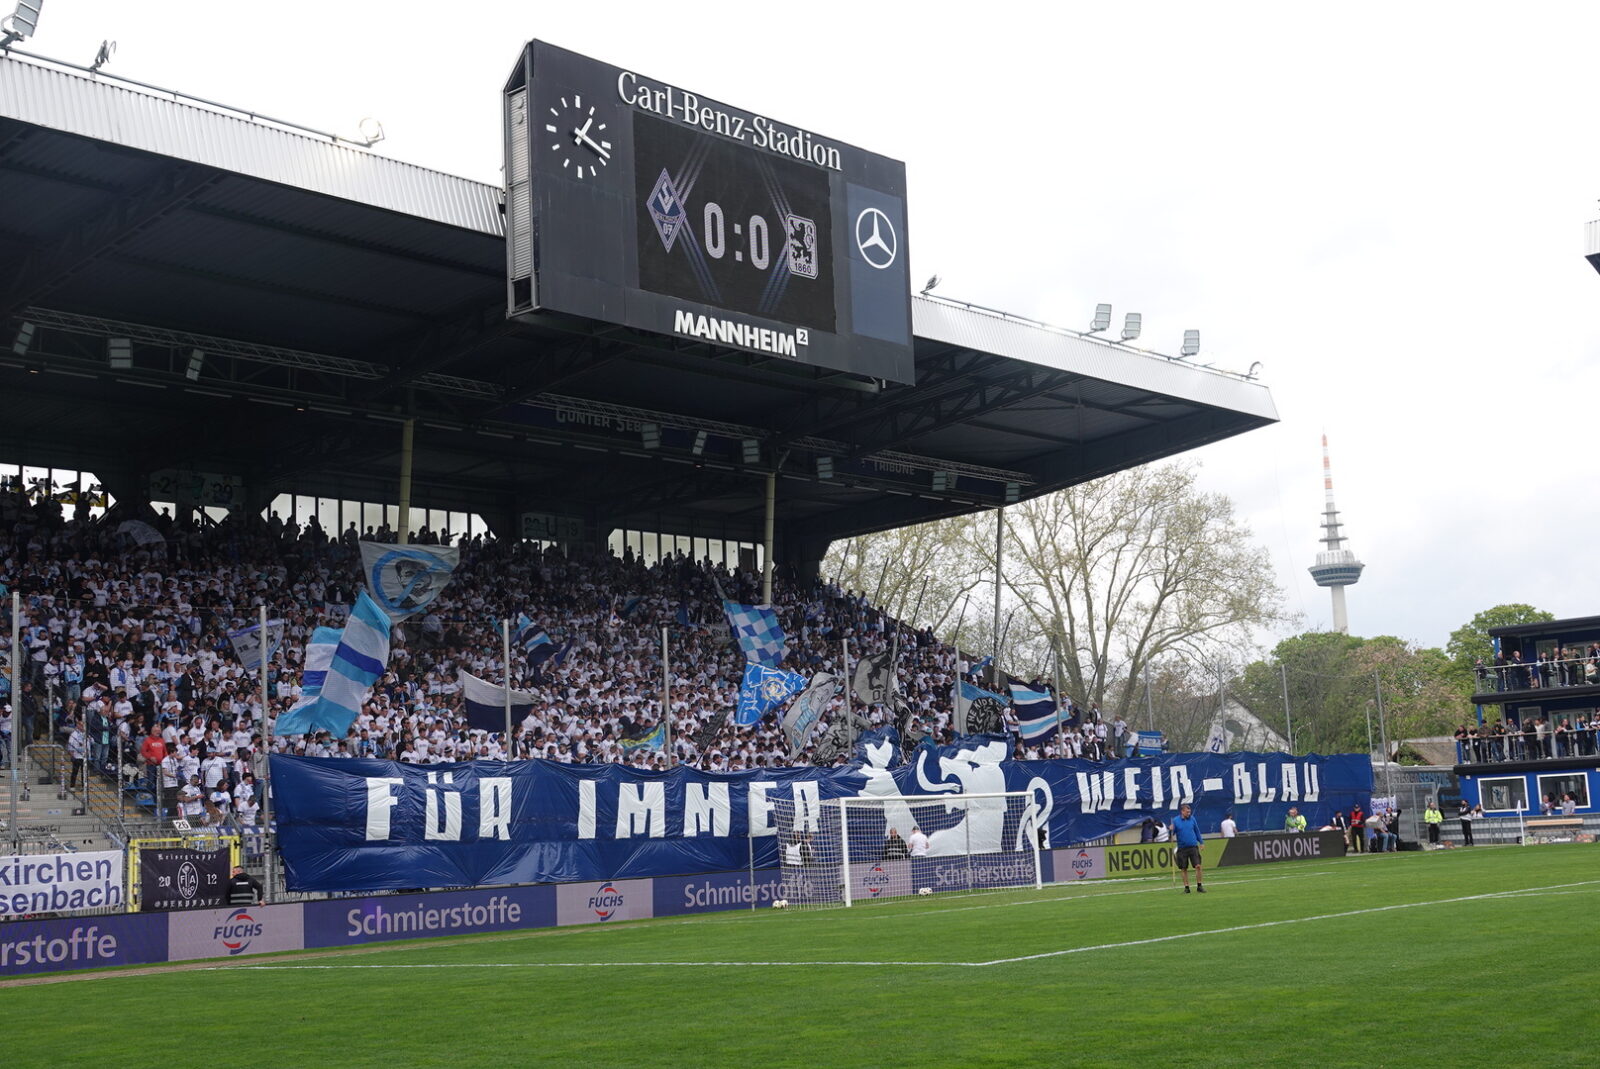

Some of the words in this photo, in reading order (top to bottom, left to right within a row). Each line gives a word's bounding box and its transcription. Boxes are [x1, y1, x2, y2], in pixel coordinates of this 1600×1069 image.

[618, 71, 842, 170] Carl-Benz-Stadion
[795, 262, 811, 273] 1860
[176, 821, 189, 830] 26
[1253, 839, 1293, 860] NEON
[1293, 837, 1321, 857] ONE
[1072, 859, 1093, 868] FUCHS
[1108, 848, 1153, 873] NEON
[0, 856, 112, 886] kirchen
[206, 873, 217, 885] 12
[863, 873, 890, 886] FUCHS
[935, 858, 1036, 887] Schmierstoffe
[158, 876, 171, 887] 20
[0, 880, 120, 914] senbach
[588, 894, 624, 909] FUCHS
[347, 895, 521, 937] Schmierstoffe
[213, 923, 263, 940] FUCHS
[0, 926, 118, 968] rstoffe
